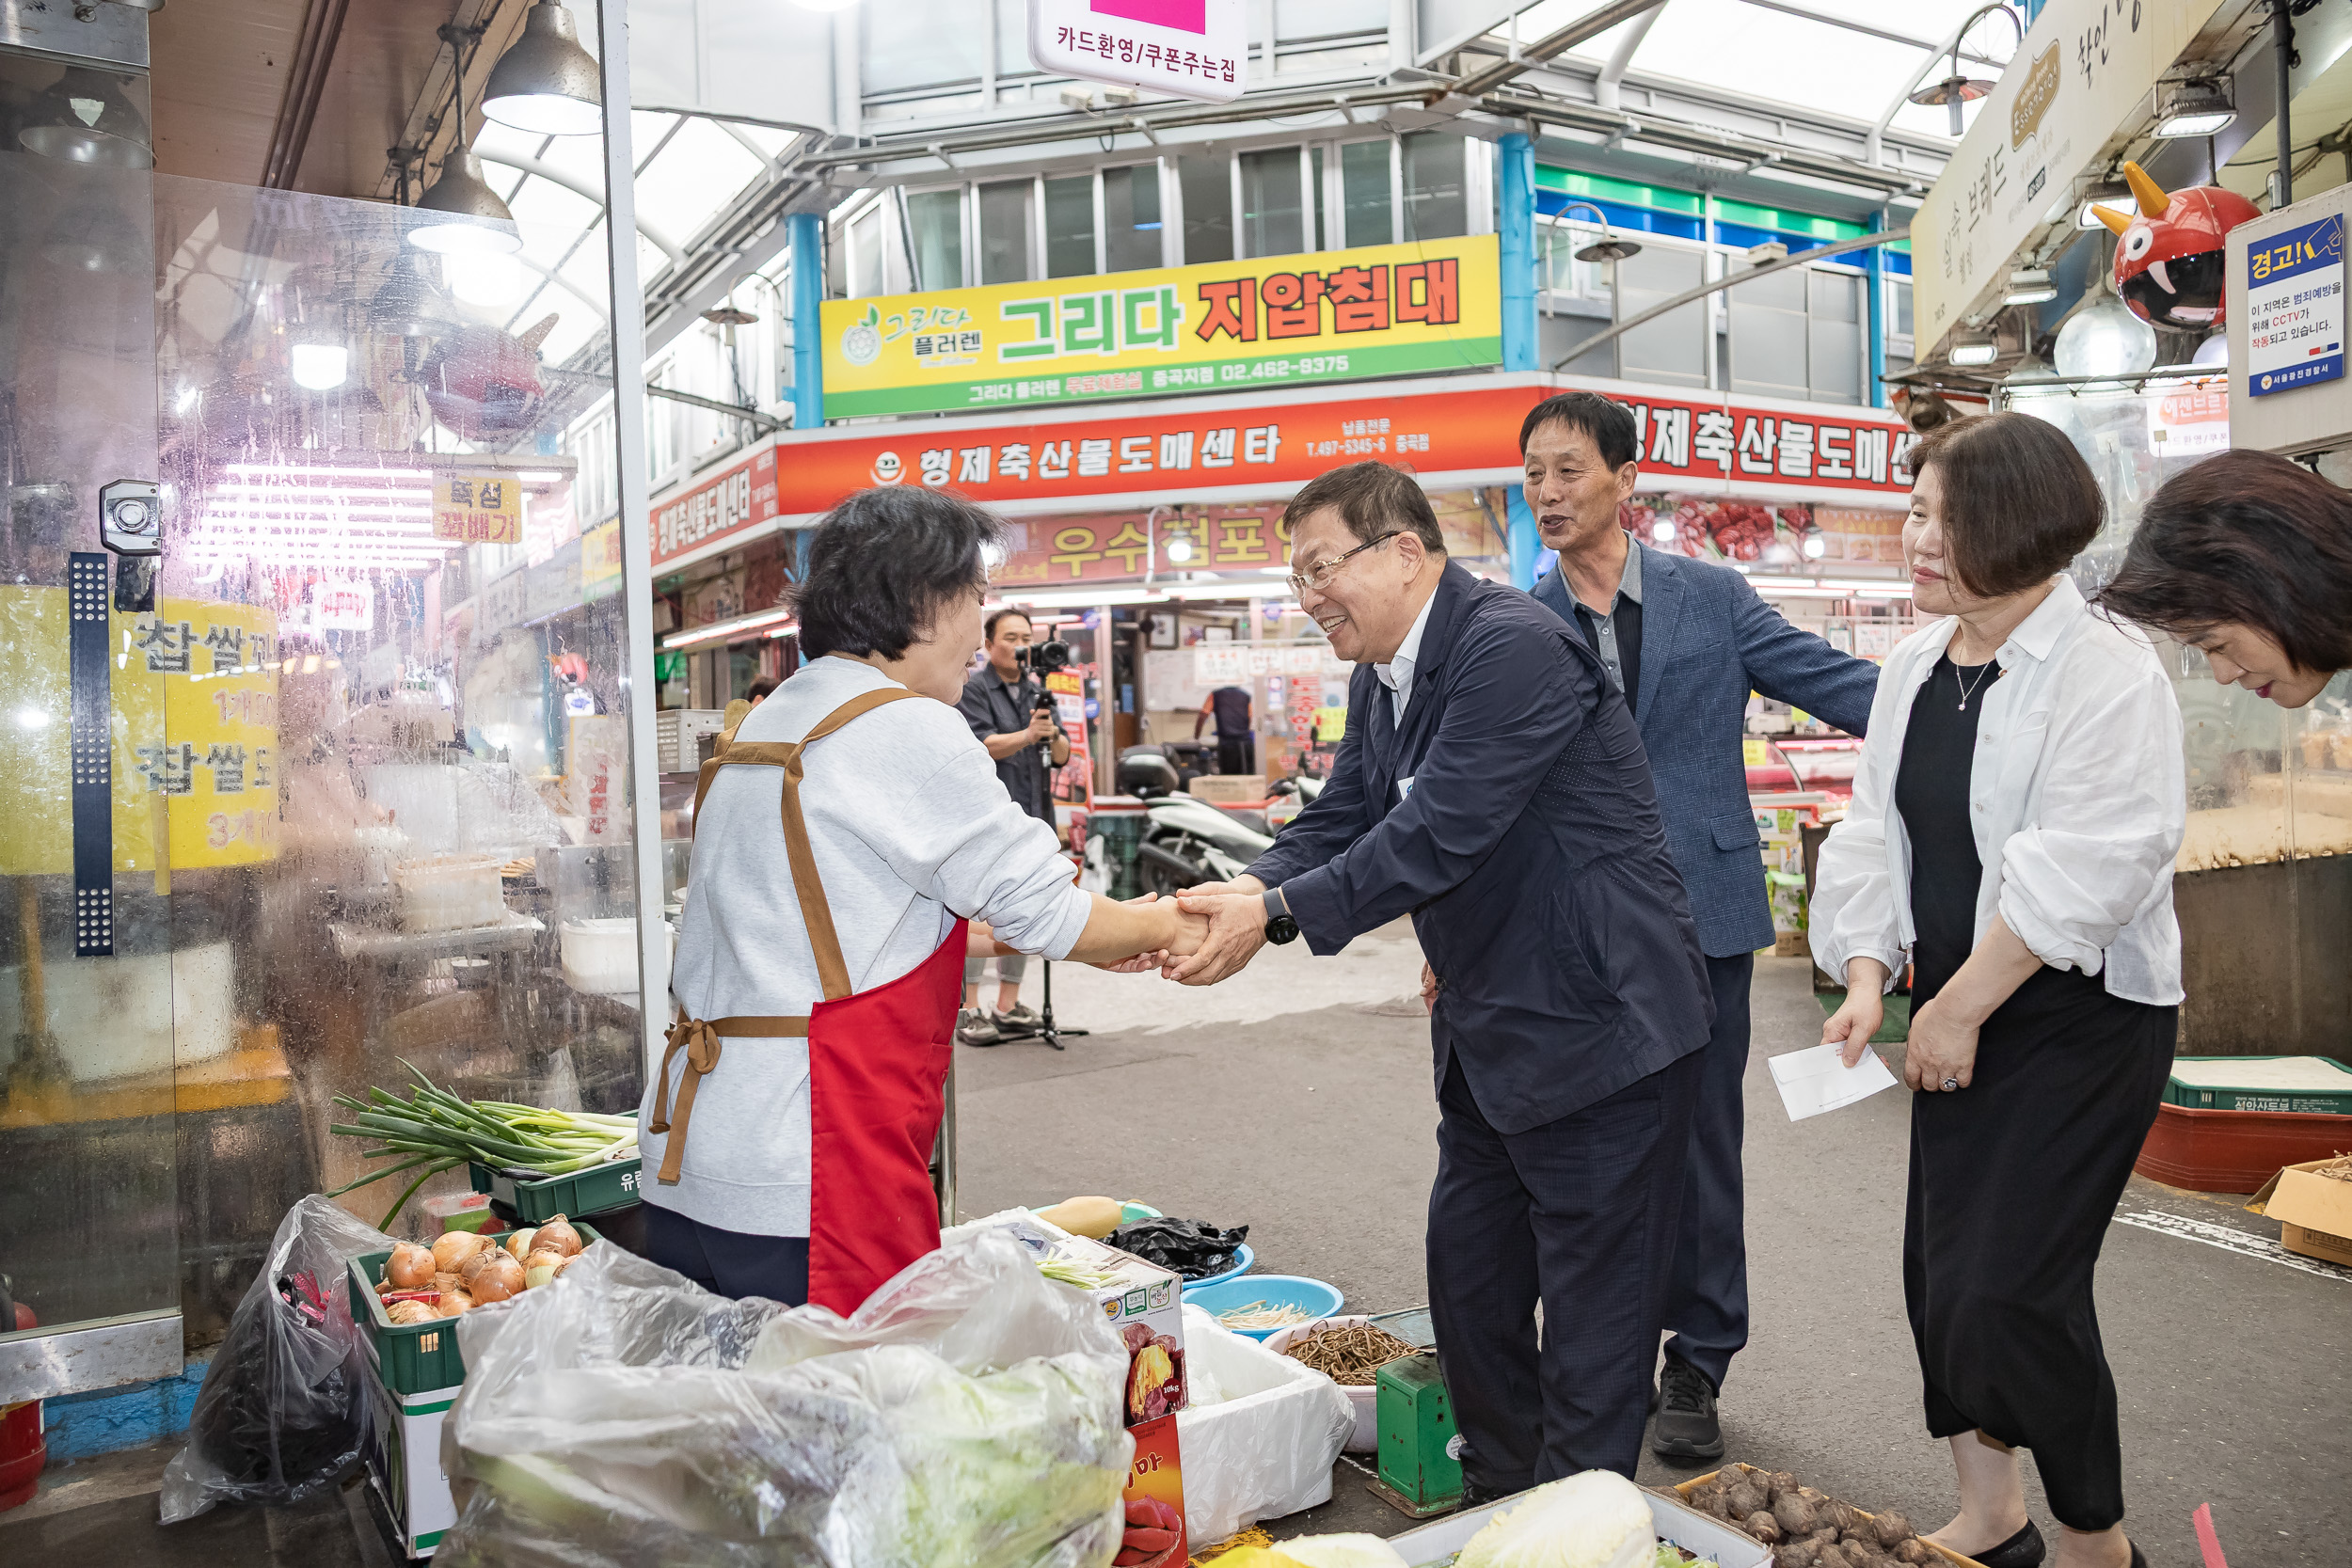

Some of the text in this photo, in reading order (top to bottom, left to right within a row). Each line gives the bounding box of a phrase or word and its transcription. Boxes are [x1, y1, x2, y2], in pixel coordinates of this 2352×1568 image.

[1057, 26, 1235, 83] 카드환영/쿠폰주는집
[2252, 242, 2302, 279] 경고!
[998, 258, 1460, 363] 그리다 지압침대
[2251, 281, 2343, 316] 이 지역은 범죄예방을
[885, 307, 973, 341] 그리다
[2251, 308, 2311, 333] 위해 CCTV가
[2251, 320, 2332, 349] 작동되고 있습니다.
[914, 331, 981, 356] 플러렌
[969, 383, 1013, 403] 그리다
[1015, 378, 1061, 399] 플러렌
[1152, 366, 1215, 388] 중곡지점
[1221, 355, 1349, 382] 02.462-9375
[2273, 364, 2329, 384] 서울광진경찰서
[1342, 418, 1391, 436] 납품전문
[919, 424, 1282, 486] 형제축산물도매센타
[1395, 433, 1430, 453] 중곡점
[440, 512, 515, 542] 꽈배기
[1163, 1385, 1180, 1394] 10kg
